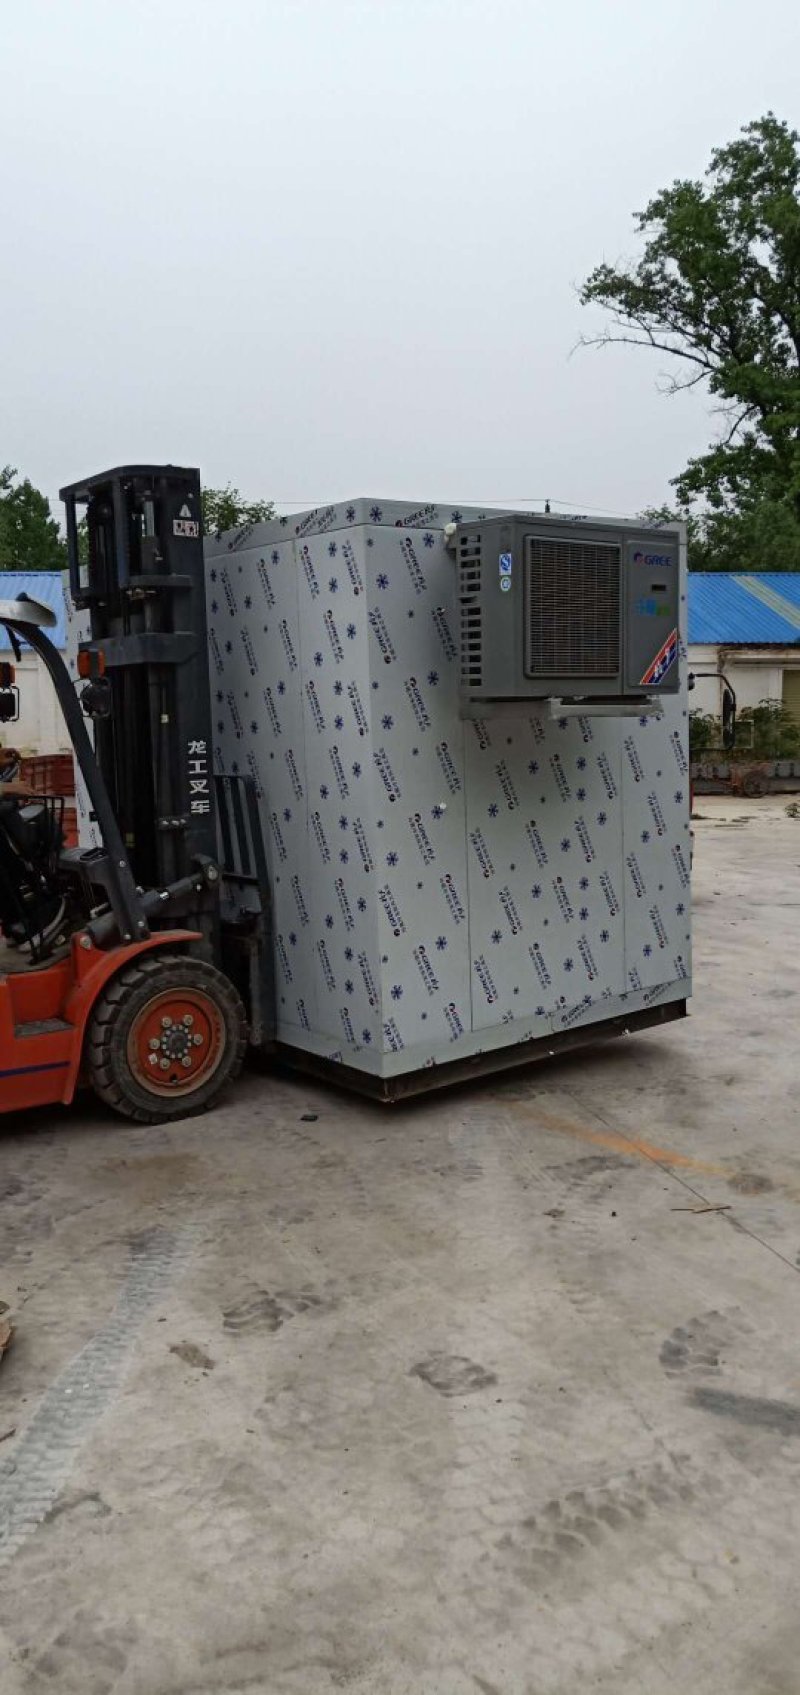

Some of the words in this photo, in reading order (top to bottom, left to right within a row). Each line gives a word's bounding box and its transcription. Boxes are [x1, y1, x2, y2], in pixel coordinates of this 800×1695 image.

[644, 555, 672, 567] GREE
[187, 740, 210, 814] 龙工叉车
